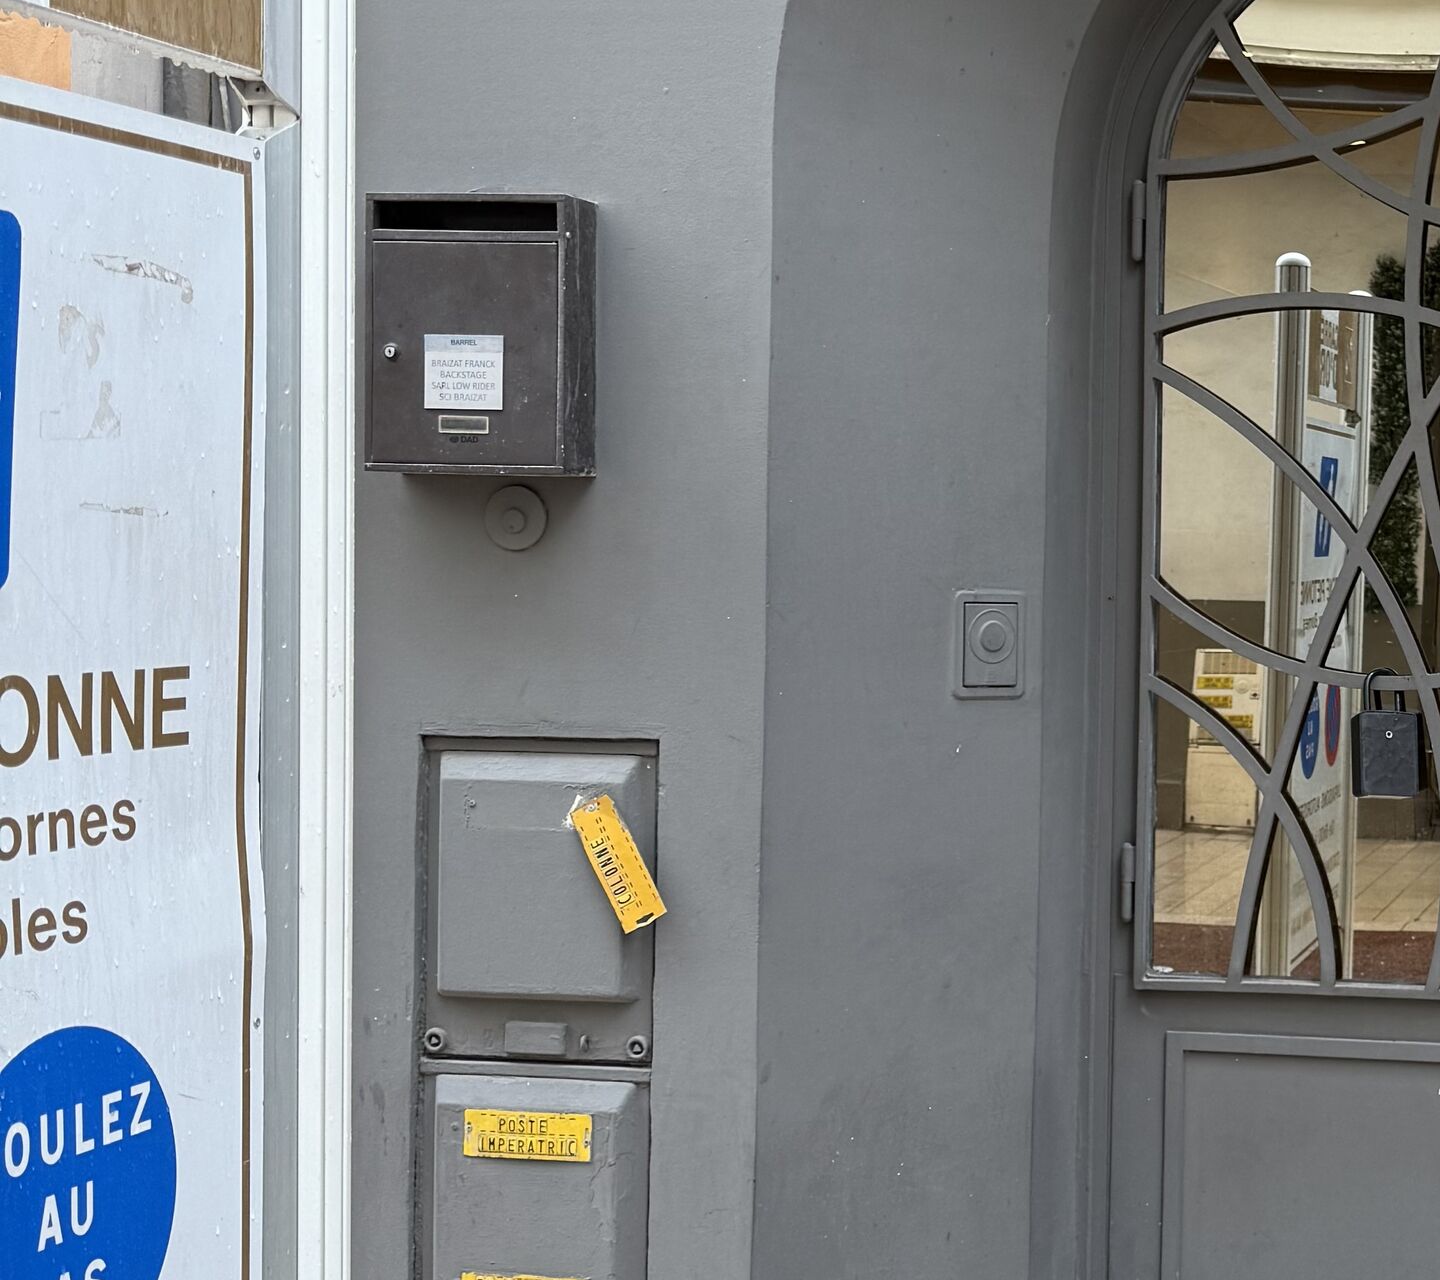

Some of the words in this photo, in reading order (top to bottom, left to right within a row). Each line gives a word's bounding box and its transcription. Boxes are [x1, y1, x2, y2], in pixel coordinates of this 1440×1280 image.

[450, 338, 478, 346] BARREL
[431, 359, 462, 368] BRAIZAT
[464, 360, 496, 368] FRANCK
[440, 371, 487, 379] BACKSTAGE
[431, 381, 450, 390] SARL
[452, 382, 471, 390] LOW
[472, 382, 496, 391] RIDER
[439, 393, 452, 401] SCI
[454, 393, 488, 402] BRAIZAT
[0, 666, 190, 768] ONNE
[590, 837, 632, 906] COLONNE
[0, 898, 88, 959] les
[4, 1080, 152, 1178] OULEZ
[498, 1119, 548, 1134] POSTE
[37, 1180, 95, 1253] AU
